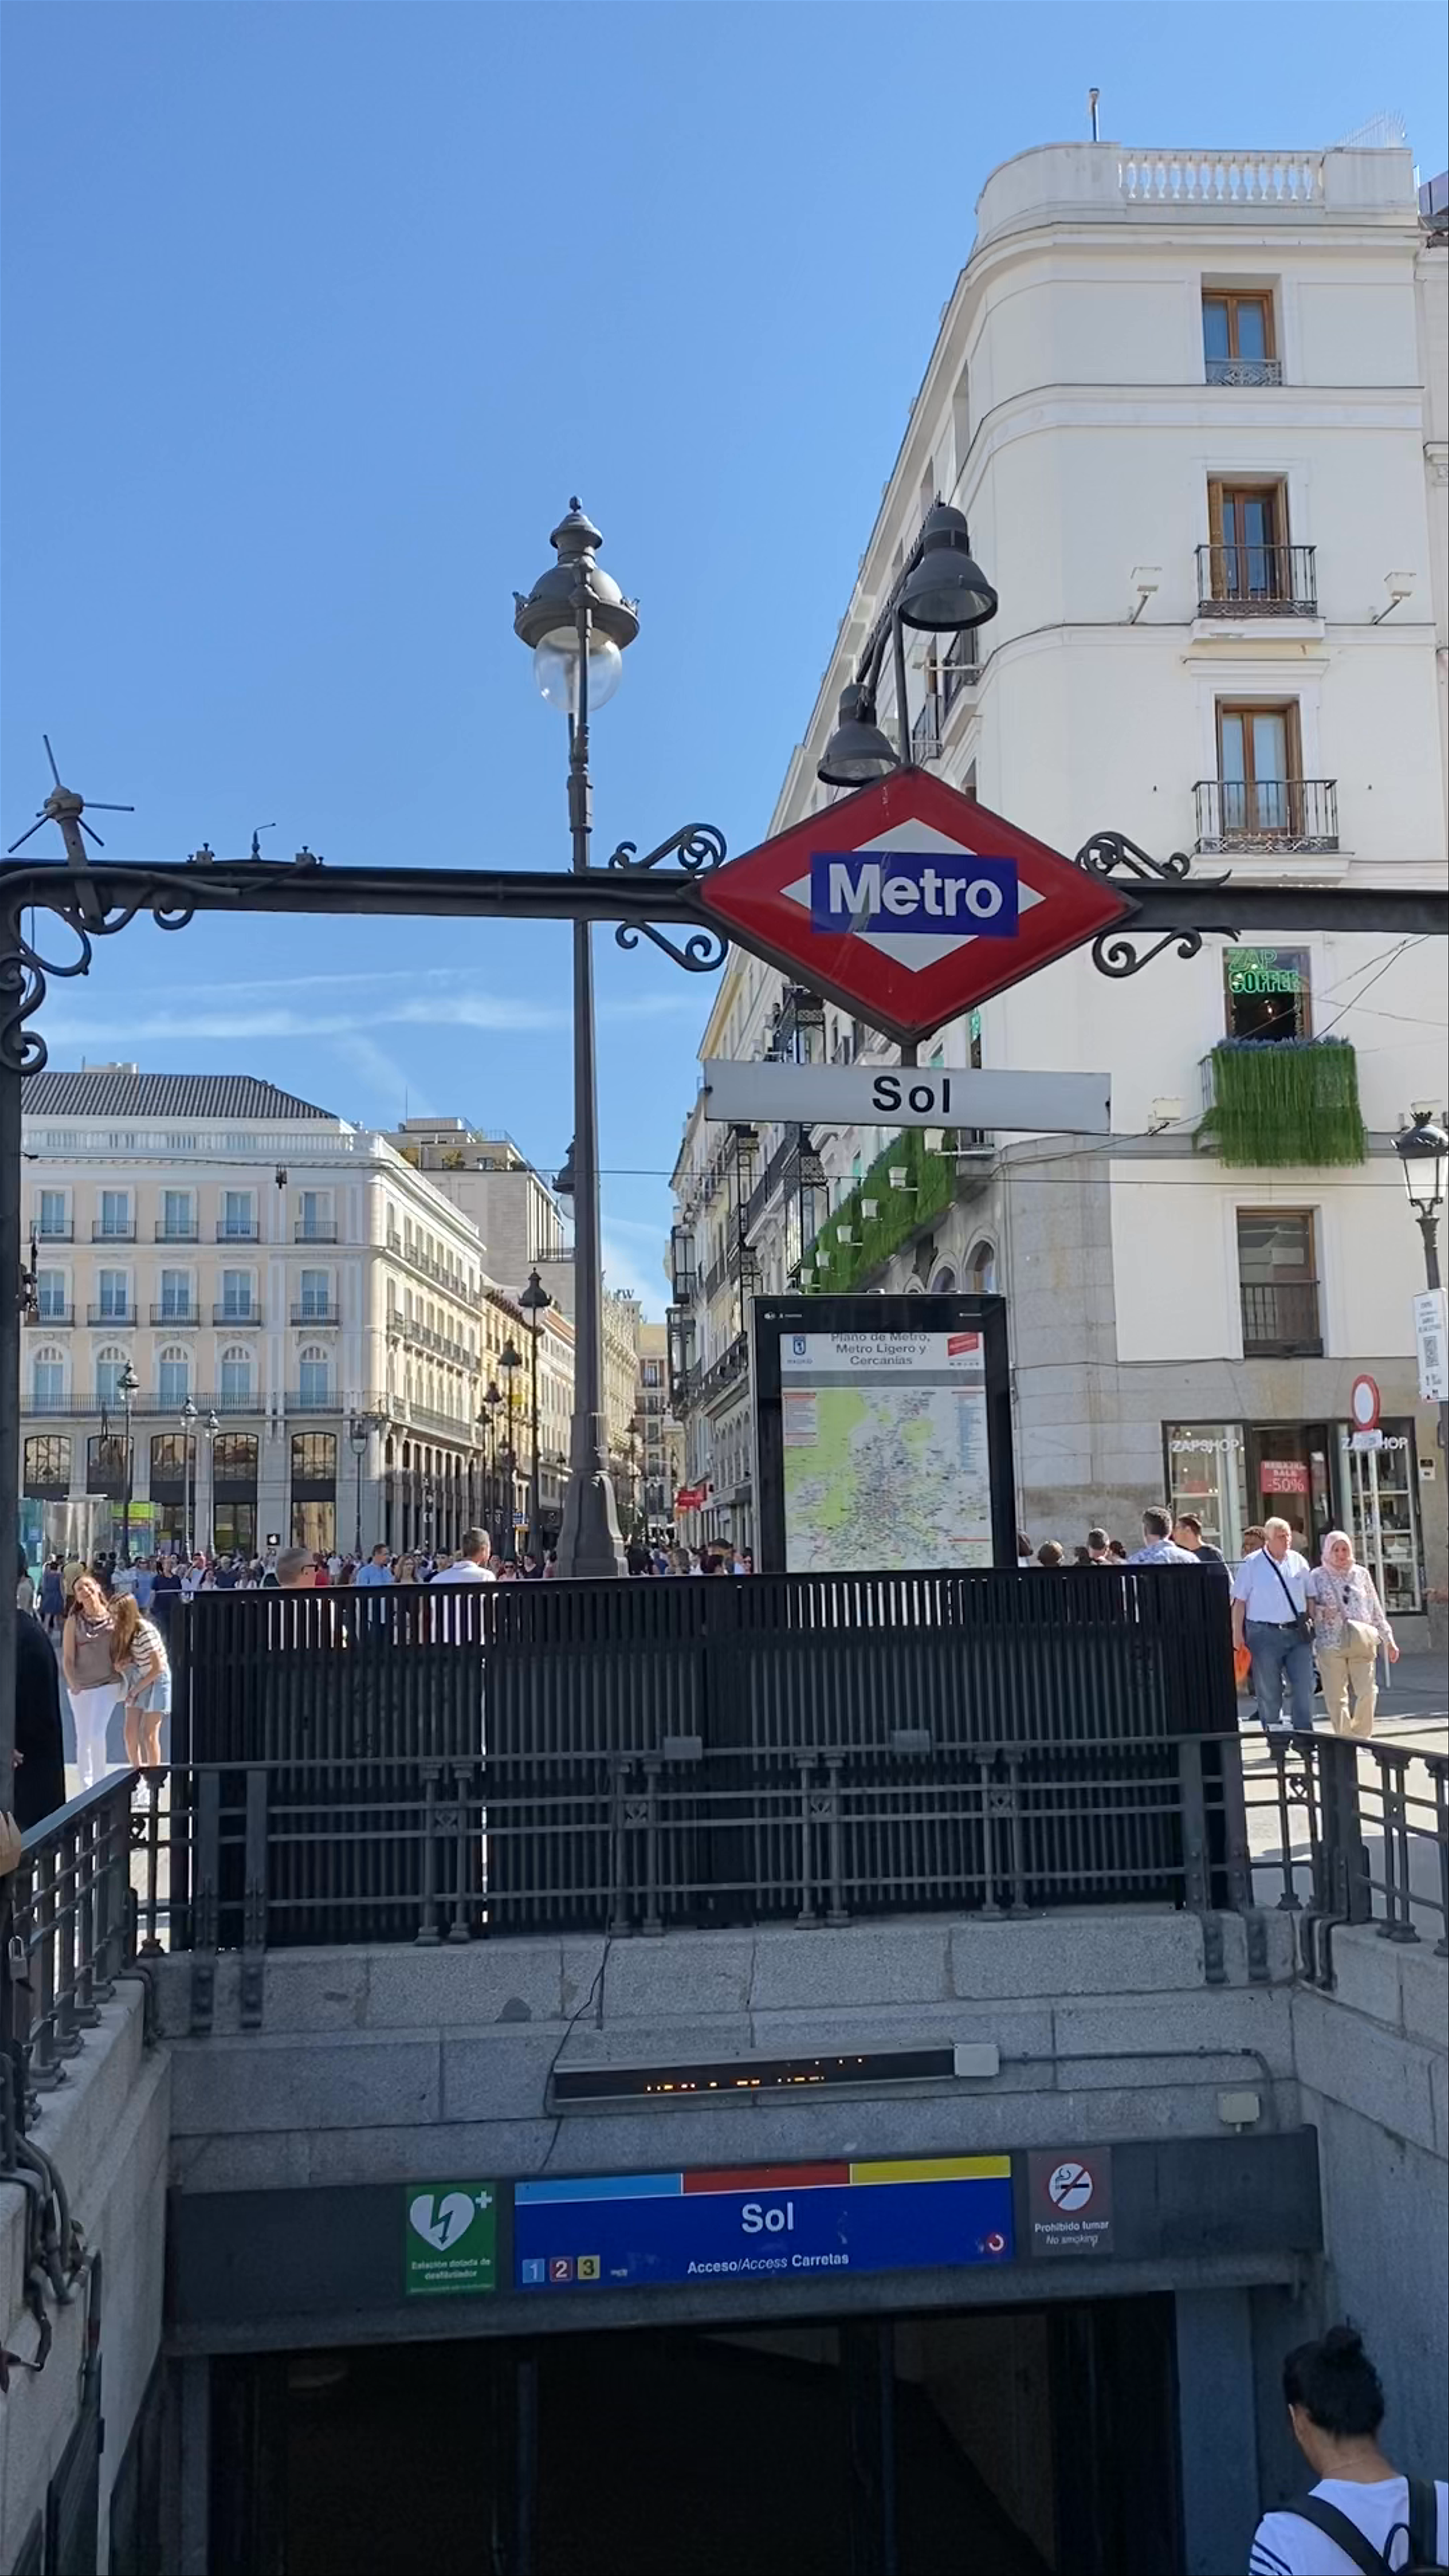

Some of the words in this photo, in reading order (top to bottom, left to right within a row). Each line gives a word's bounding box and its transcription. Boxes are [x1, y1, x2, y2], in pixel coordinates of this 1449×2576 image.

[829, 863, 1003, 918] Metro
[1228, 949, 1277, 971] ZAP
[1229, 970, 1299, 993] COFFEE
[872, 1075, 950, 1113] Sol
[831, 1333, 867, 1341] Plano
[871, 1333, 886, 1341] de
[836, 1343, 873, 1353] Metro
[876, 1344, 915, 1355] Ligero
[919, 1346, 926, 1355] y
[1172, 1439, 1240, 1452] ZAPSHOP
[1267, 1478, 1304, 1492] -50%
[742, 2202, 794, 2233] Sol
[1035, 2221, 1080, 2233] Prohibido
[1082, 2221, 1109, 2230] fumar
[1046, 2235, 1060, 2244] No
[1061, 2234, 1098, 2248] smoking
[530, 2263, 537, 2280] 1
[556, 2260, 568, 2278] 2
[583, 2259, 595, 2276] 3
[688, 2258, 788, 2274] Acceso/Access
[792, 2250, 849, 2267] Carretas
